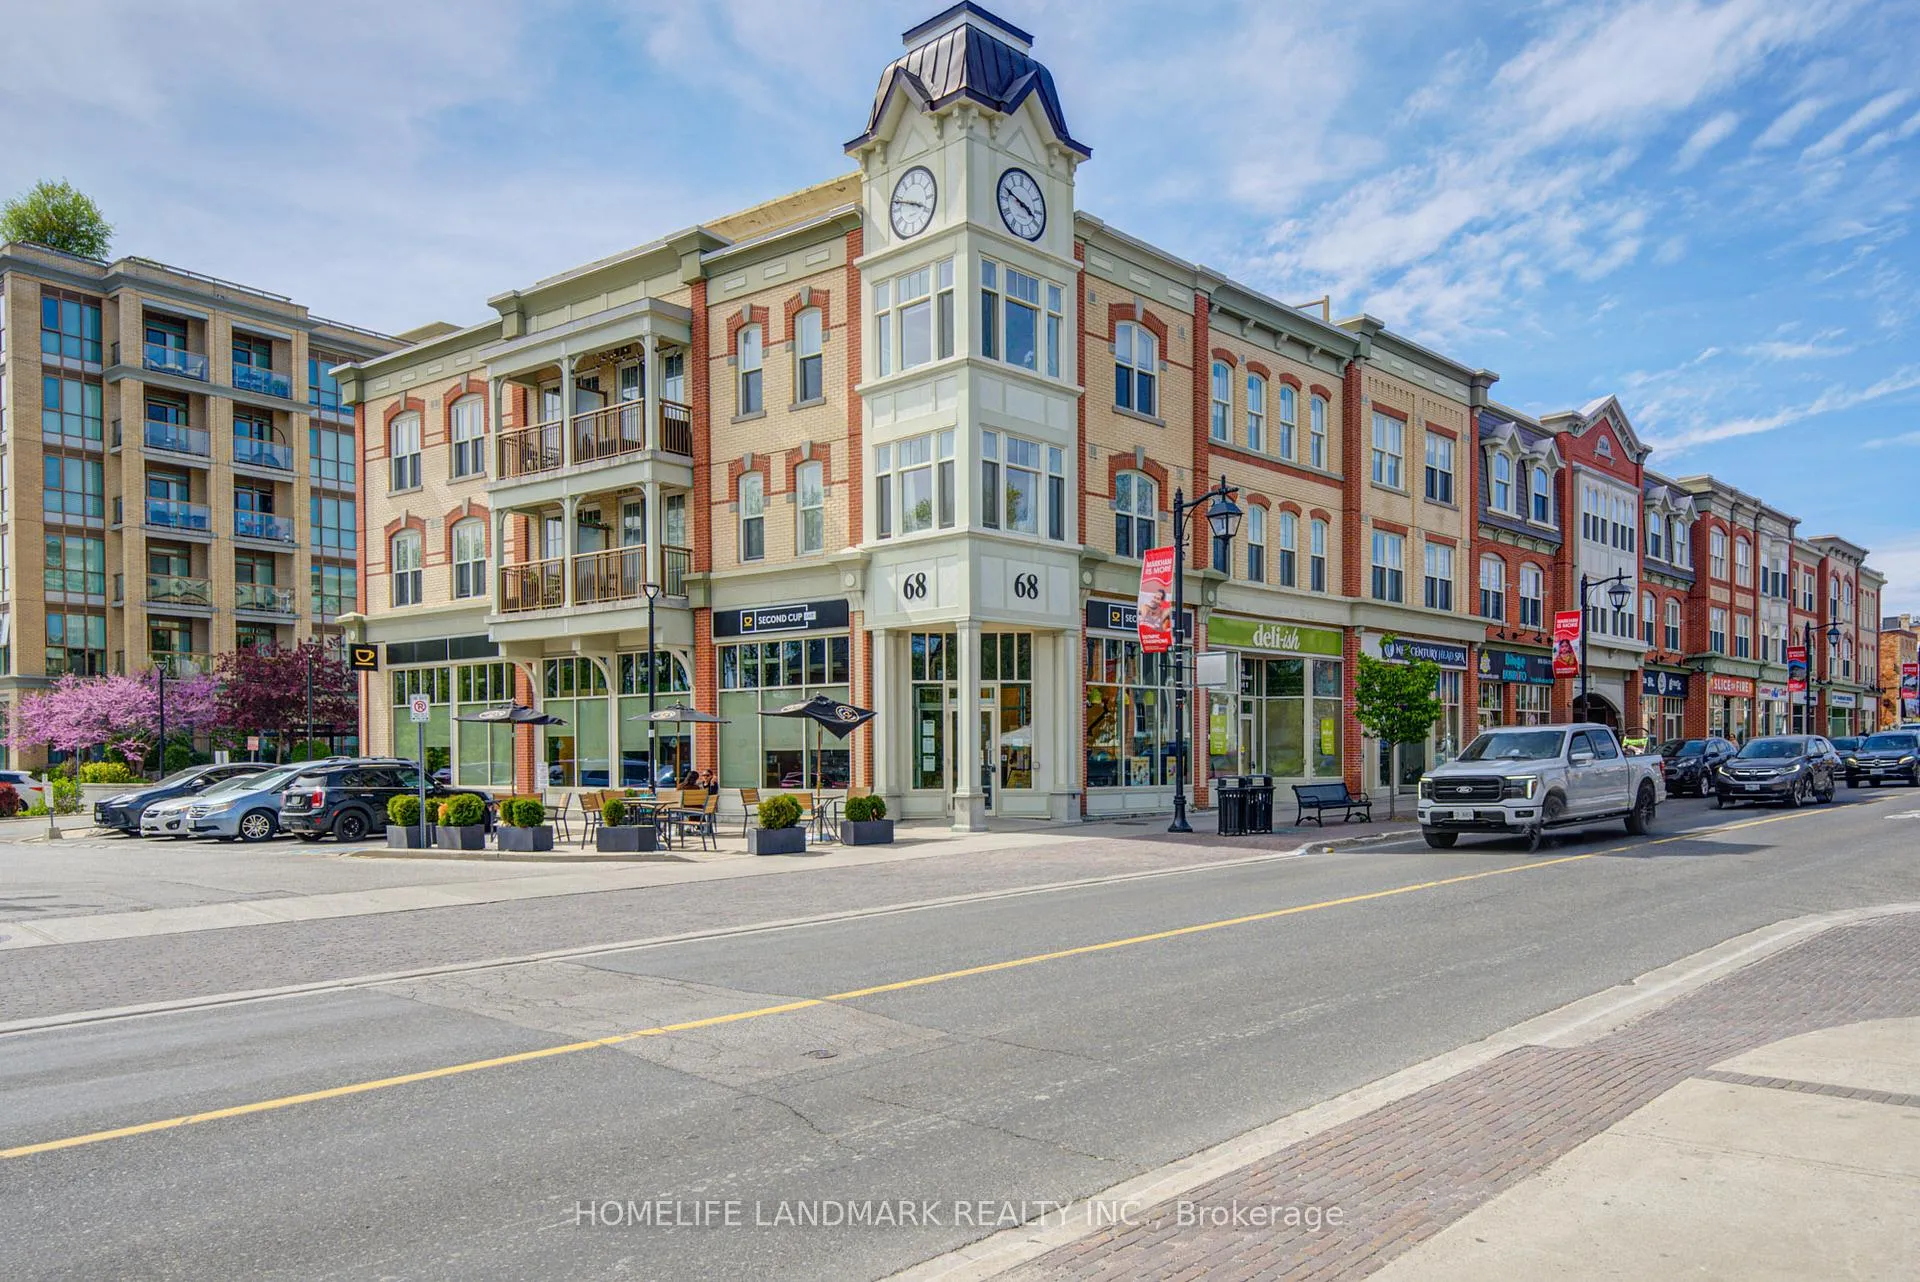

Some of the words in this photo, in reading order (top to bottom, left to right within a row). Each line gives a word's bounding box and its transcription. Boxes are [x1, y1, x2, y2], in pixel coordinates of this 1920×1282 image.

[903, 572, 927, 600] 68
[1014, 572, 1039, 600] 68
[758, 614, 787, 625] SECOND
[788, 612, 803, 622] CUP
[1253, 624, 1301, 650] deli-ish
[1411, 646, 1438, 660] CENTURY
[1454, 652, 1466, 664] SPA
[1714, 679, 1731, 691] SLICE
[1736, 680, 1749, 693] FIRE
